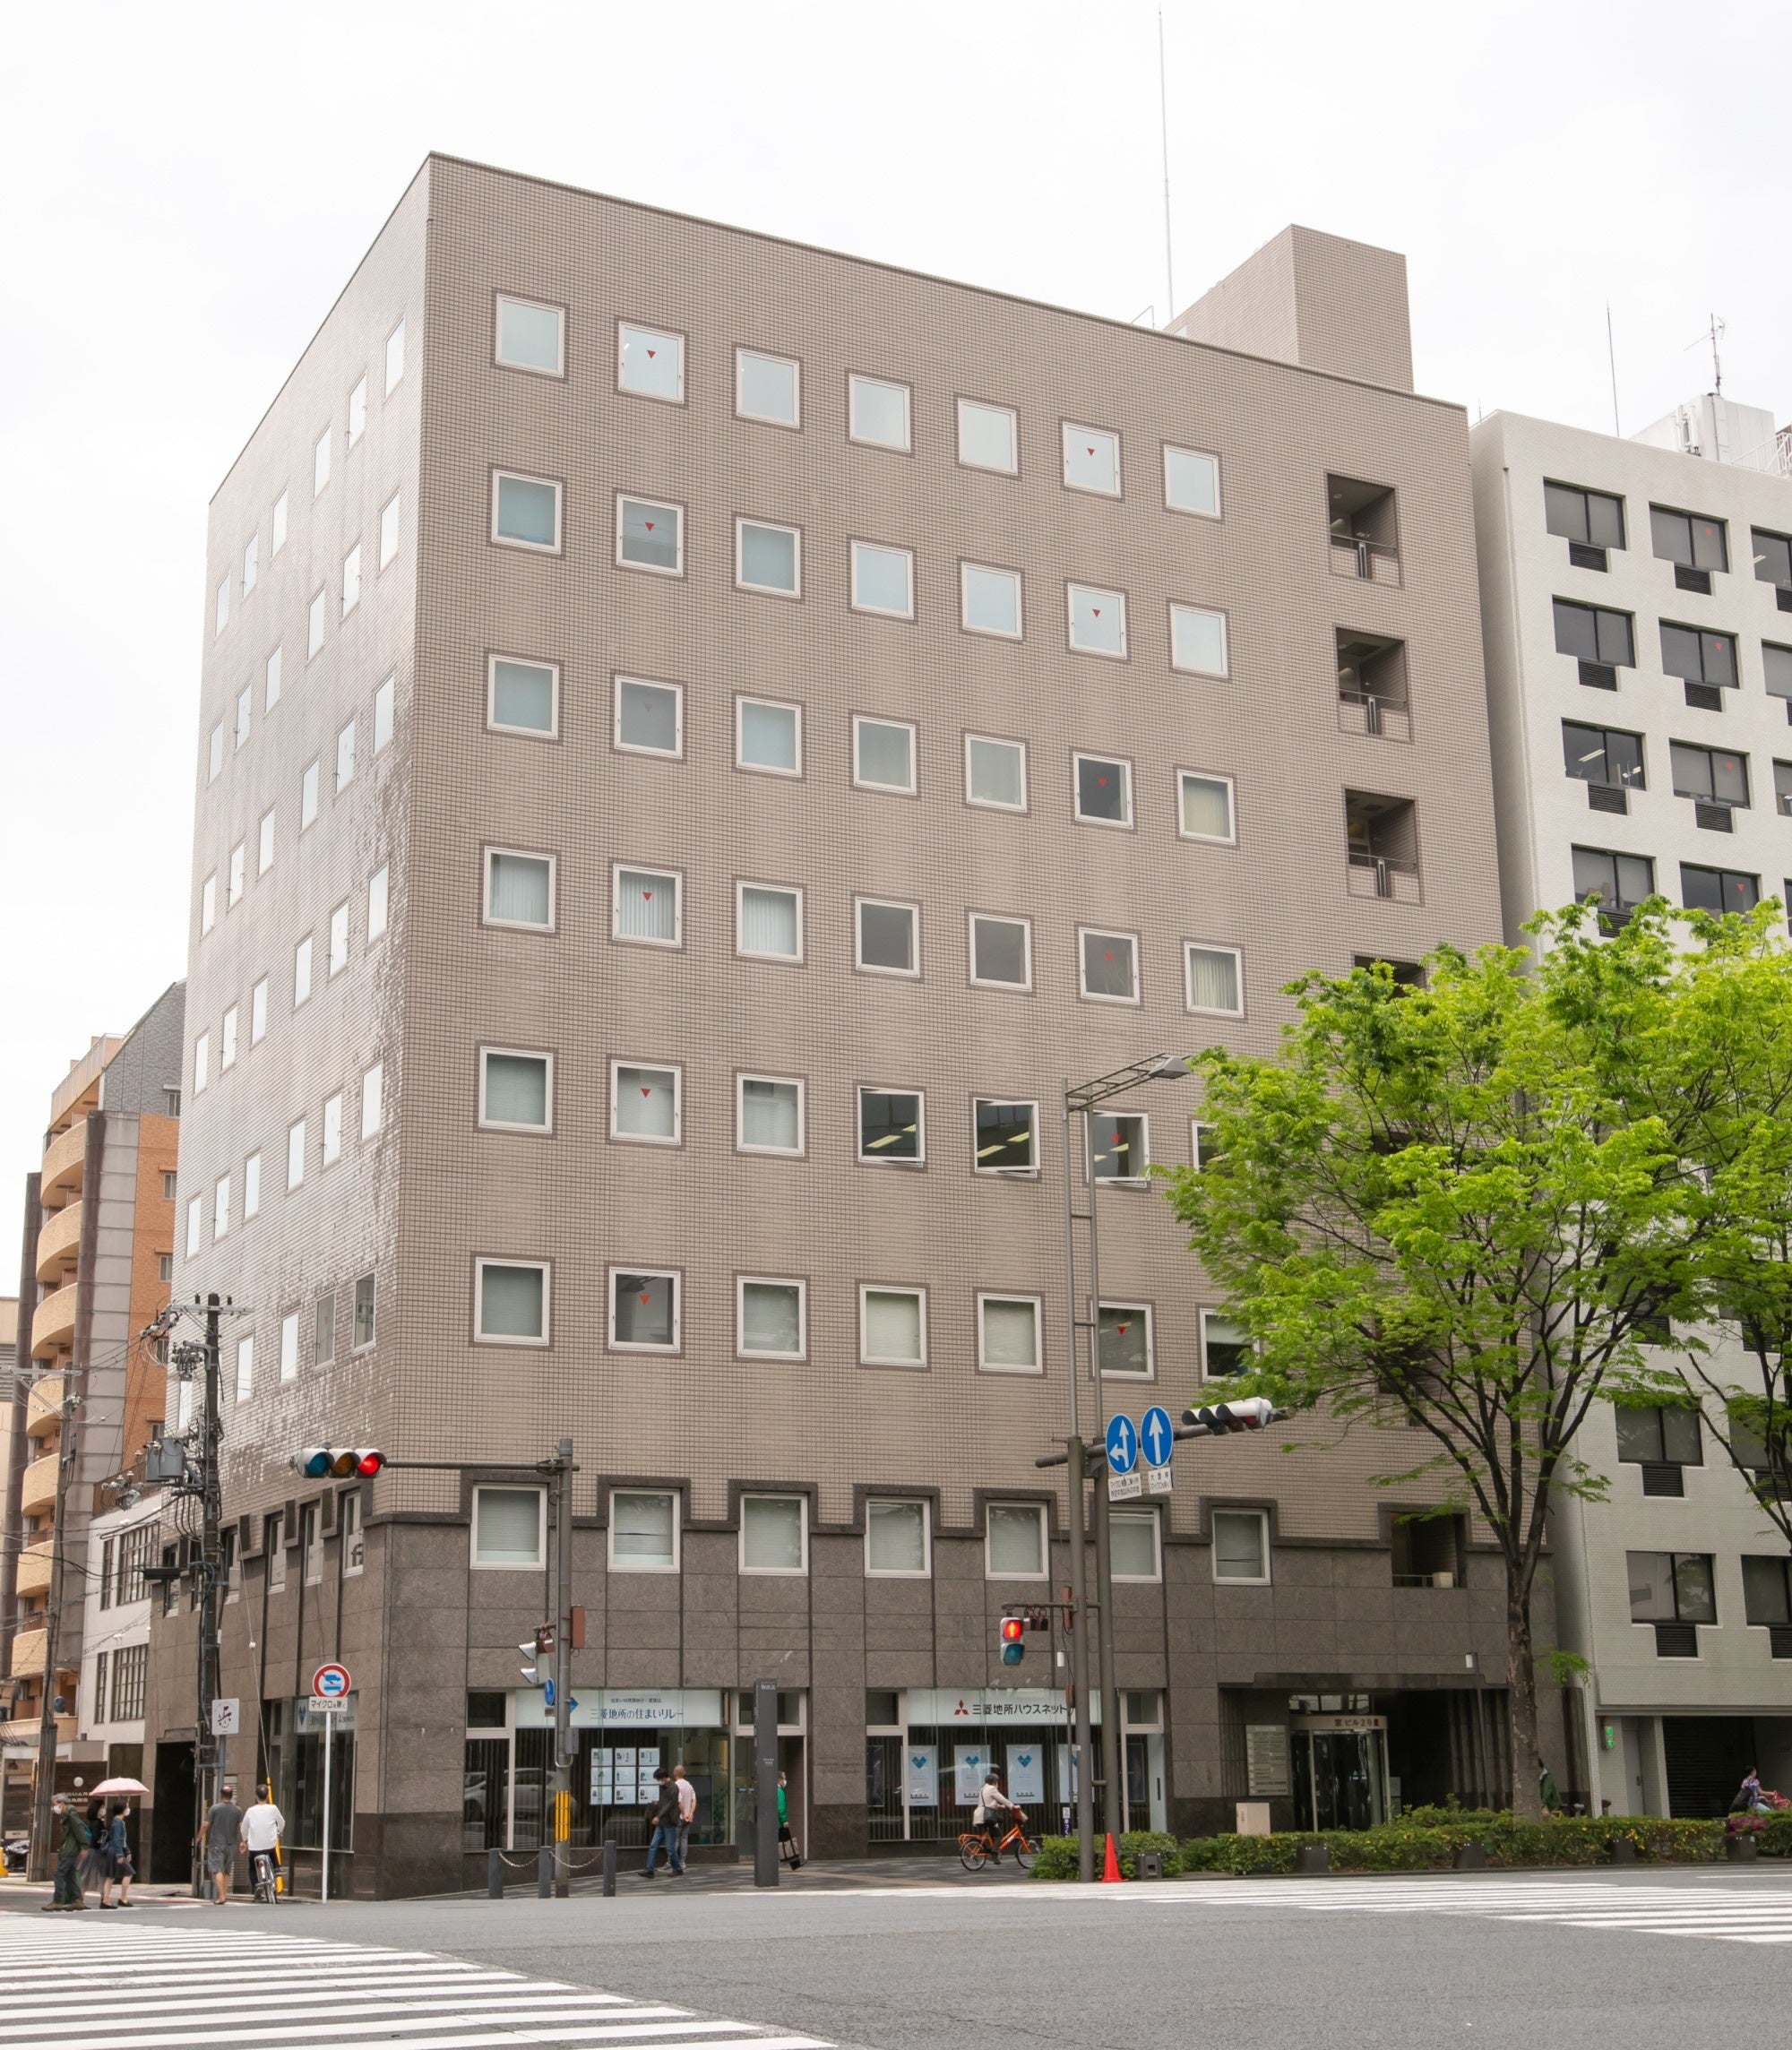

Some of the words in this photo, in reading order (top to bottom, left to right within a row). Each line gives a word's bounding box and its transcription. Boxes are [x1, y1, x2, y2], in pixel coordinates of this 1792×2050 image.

[590, 1708, 684, 1719] 三菱地所の住まいリレー
[972, 1703, 1069, 1716] 三菱地所ハウスネット
